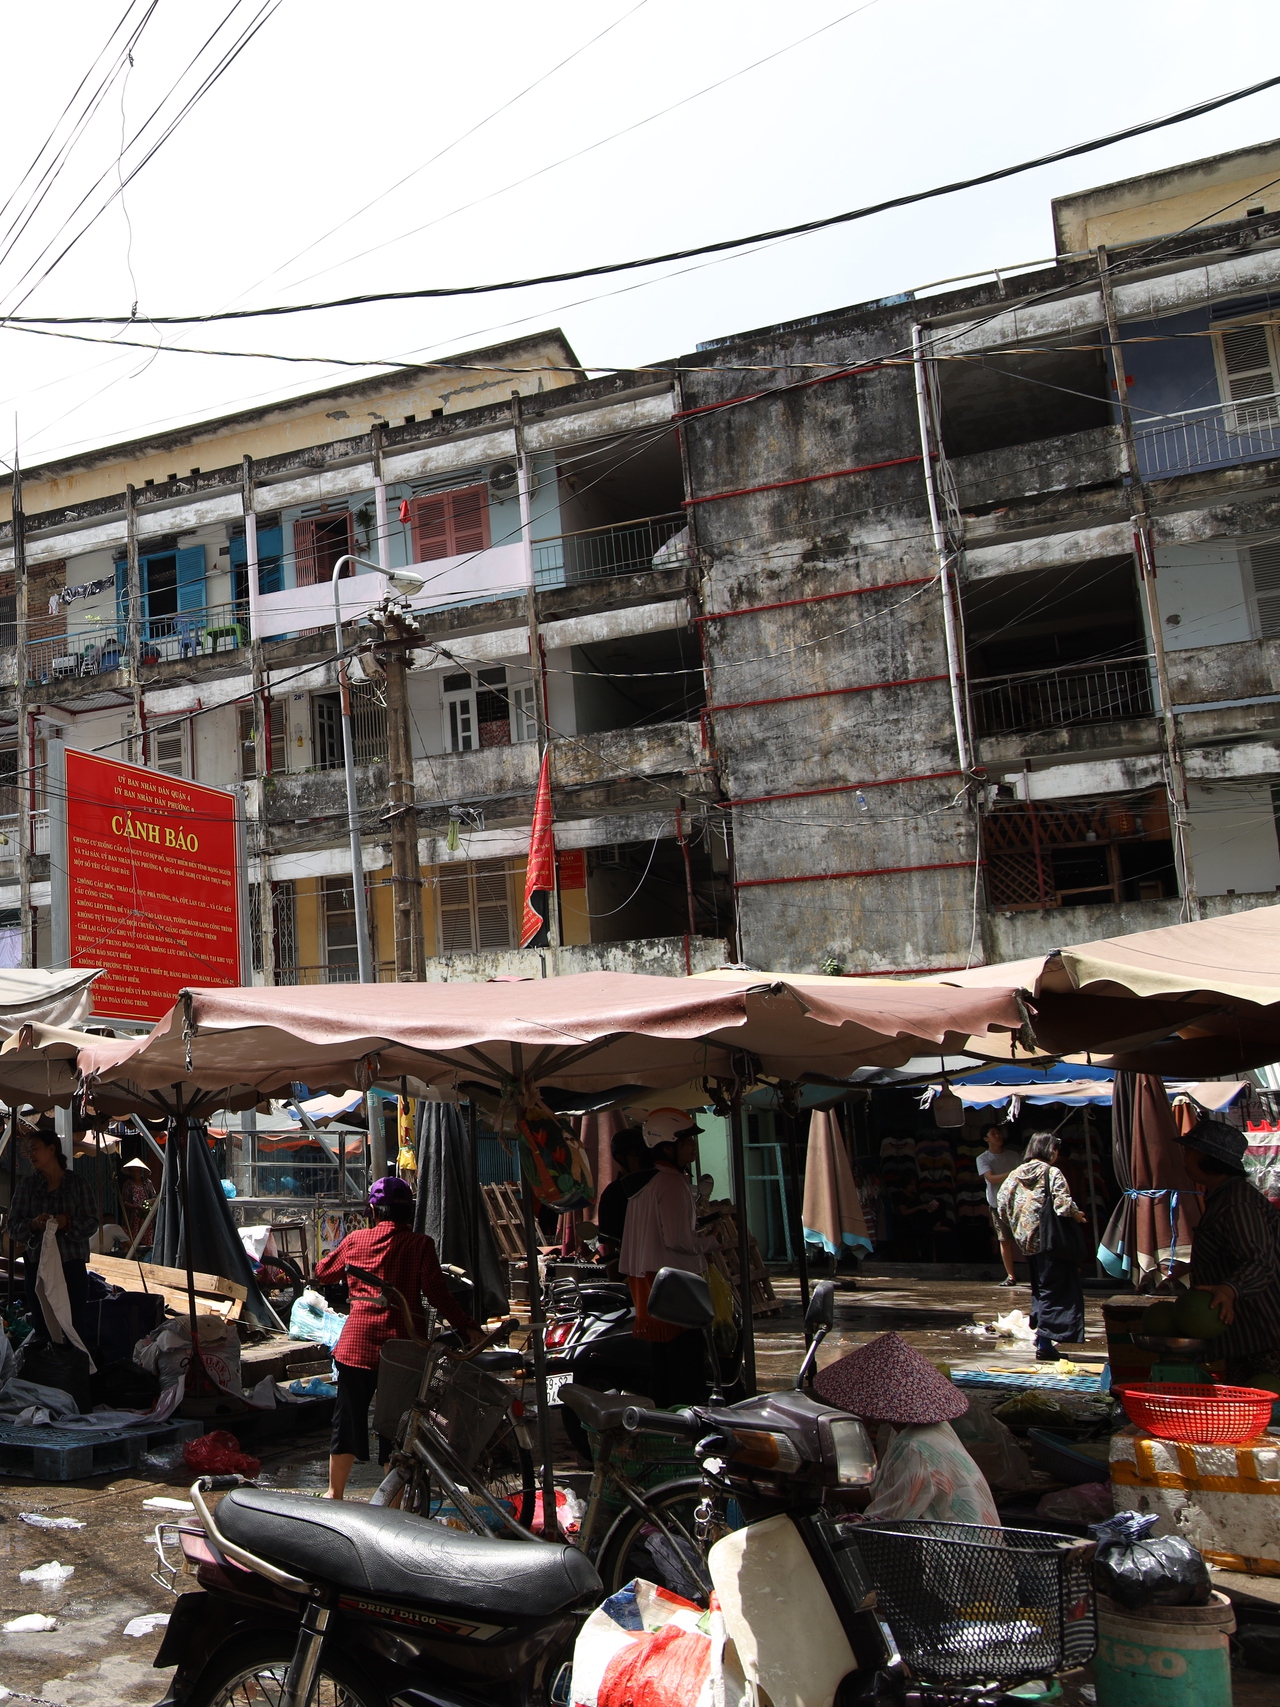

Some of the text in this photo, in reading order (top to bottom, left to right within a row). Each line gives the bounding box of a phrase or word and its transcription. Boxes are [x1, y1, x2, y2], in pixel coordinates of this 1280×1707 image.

[114, 787, 122, 795] UỶ
[124, 790, 136, 798] BAN
[137, 793, 153, 803] NHÂN
[155, 798, 166, 806] DÂN
[168, 802, 190, 813] PHƯỜNG
[118, 776, 126, 784] UỶ
[128, 779, 139, 788] BAN
[141, 782, 157, 792] NHÂN
[158, 787, 170, 796] DÂN
[172, 791, 186, 801] QUẬN
[112, 811, 198, 852] CẢNH BÁO
[546, 1376, 568, 1390] 9-S2
[358, 1602, 396, 1616] DRINI
